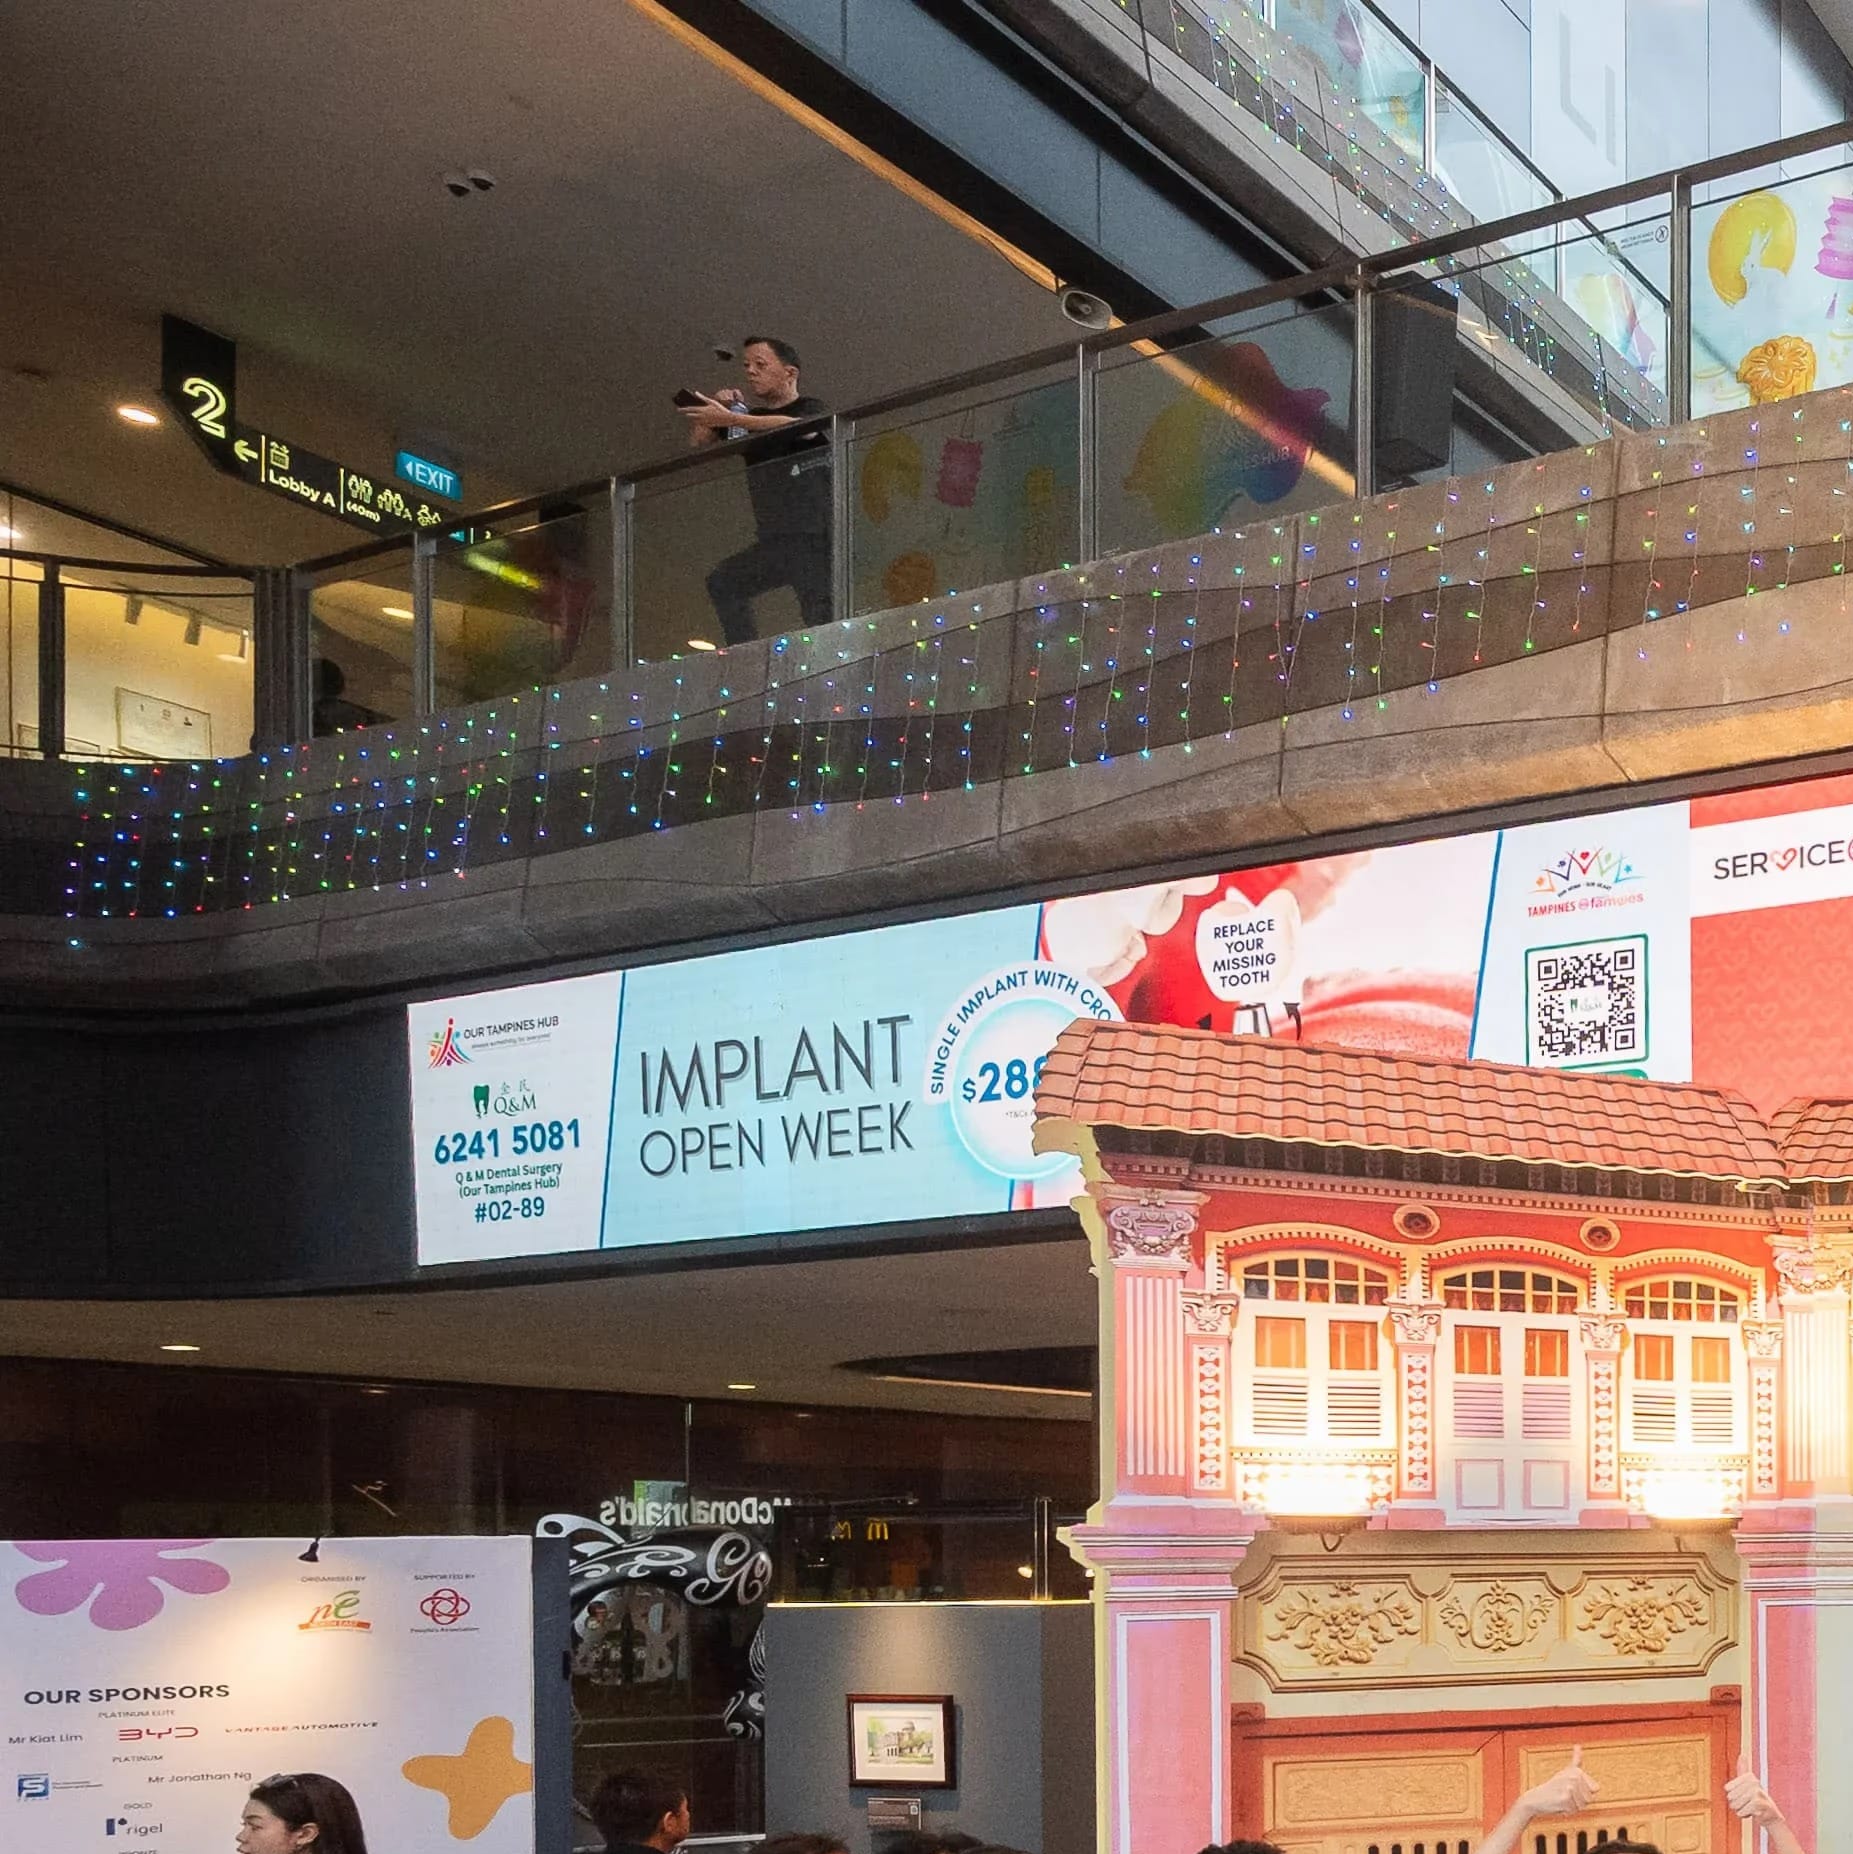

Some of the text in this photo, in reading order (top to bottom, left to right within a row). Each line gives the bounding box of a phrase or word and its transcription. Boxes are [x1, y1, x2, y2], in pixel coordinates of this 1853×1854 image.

[183, 377, 226, 439] 2
[269, 470, 336, 508] Lobby A
[414, 465, 454, 494] EXIT
[346, 501, 381, 523] (40m)
[1528, 901, 1576, 917] TAMPINES
[1212, 918, 1276, 940] REPLACE
[1223, 937, 1265, 954] YOUR
[1212, 952, 1276, 973] MISSING
[1218, 969, 1271, 988] TOOTH
[463, 1016, 559, 1039] OUR TAMPINES HUB
[931, 1023, 960, 1095] SINGLE
[957, 970, 1028, 1024] IMPLANT
[1034, 970, 1079, 995] WITH
[639, 1014, 912, 1116] IMPLANT
[494, 1093, 536, 1117] Q&M
[434, 1118, 580, 1165] 6241 5081
[639, 1099, 915, 1177] OPEN WEEK
[456, 1162, 563, 1185] Q & M Dental Surgery
[459, 1175, 560, 1199] (Our Tampines Hub)
[474, 1197, 545, 1223] #02-89
[24, 1684, 230, 1705] OUR SPONSORS
[98, 1710, 149, 1720] PLATINUM
[291, 1722, 379, 1730] AUTOMOTIVE
[9, 1733, 83, 1745] Mr Kiat Lim
[119, 1726, 199, 1742] BYD
[112, 1755, 164, 1763] PLATINUM
[148, 1771, 252, 1784] Mr Jonathan Ng
[126, 1823, 163, 1837] rigel
